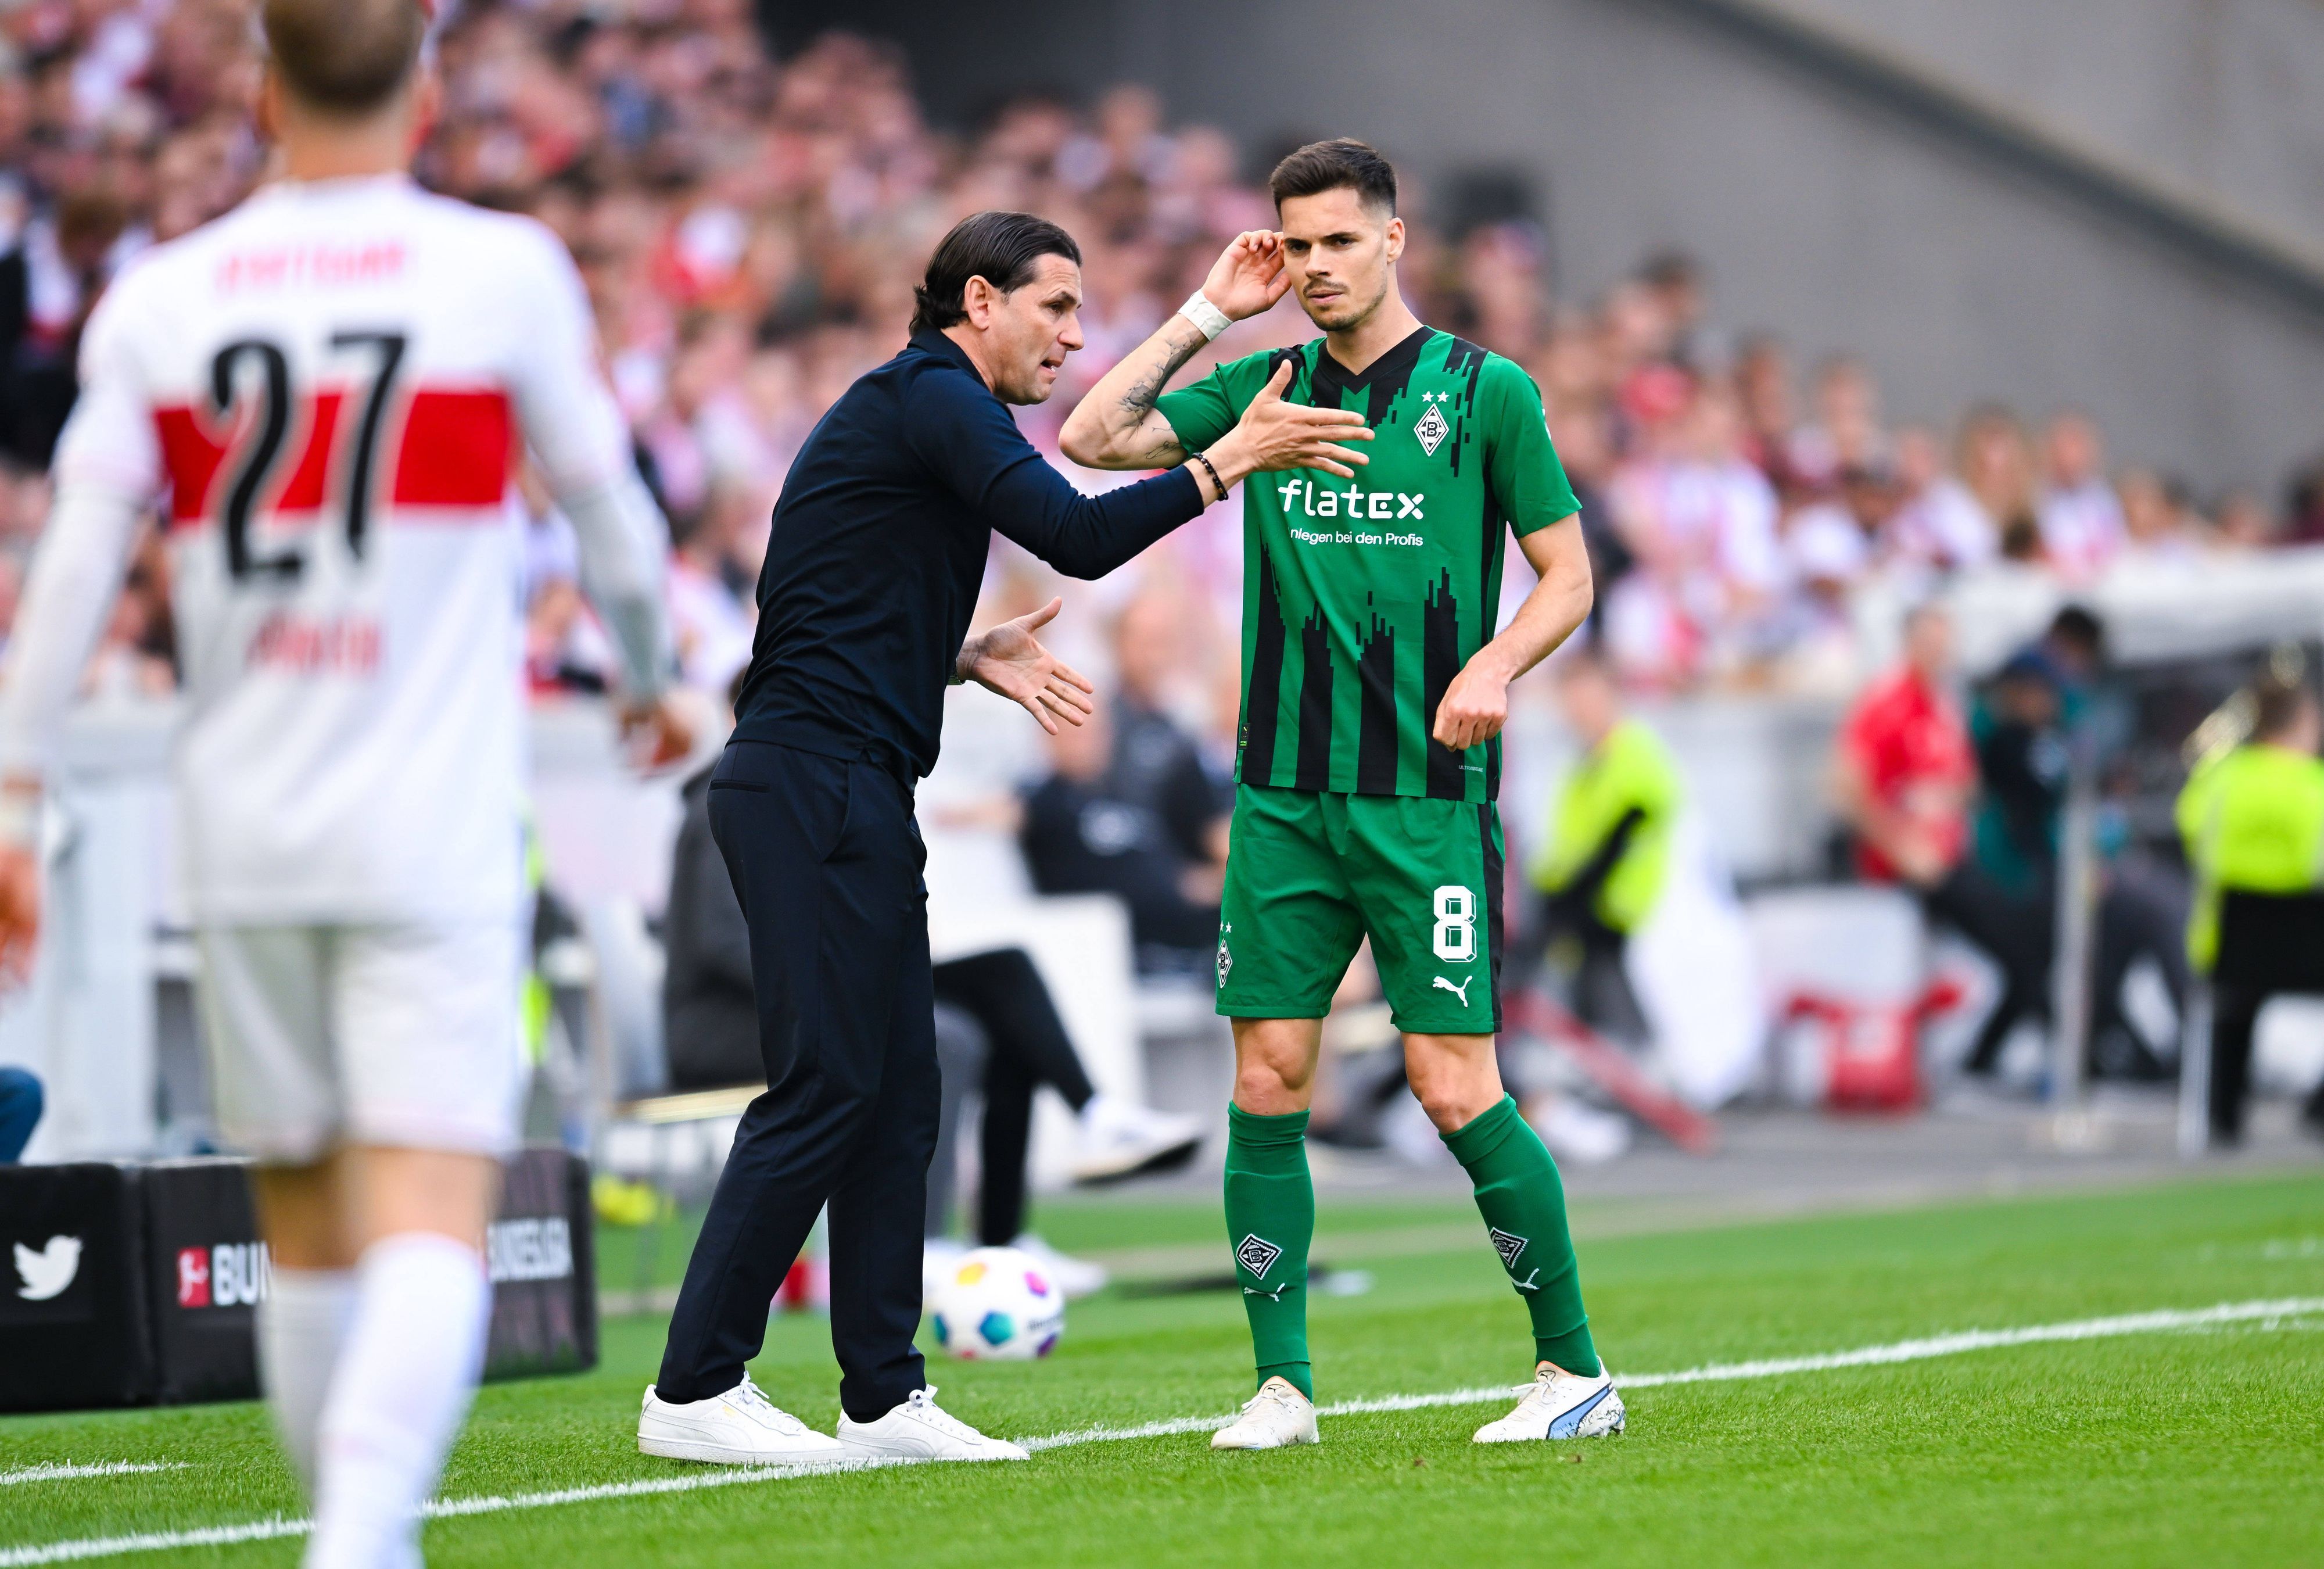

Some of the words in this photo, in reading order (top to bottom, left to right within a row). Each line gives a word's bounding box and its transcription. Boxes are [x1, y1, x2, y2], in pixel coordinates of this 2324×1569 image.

[1426, 421, 1438, 437] B
[210, 329, 410, 579] 27
[1288, 527, 1333, 545] nlegen
[1336, 531, 1353, 543] bei
[1355, 532, 1382, 545] den
[1386, 533, 1423, 546] Profis
[1433, 885, 1477, 962] 8
